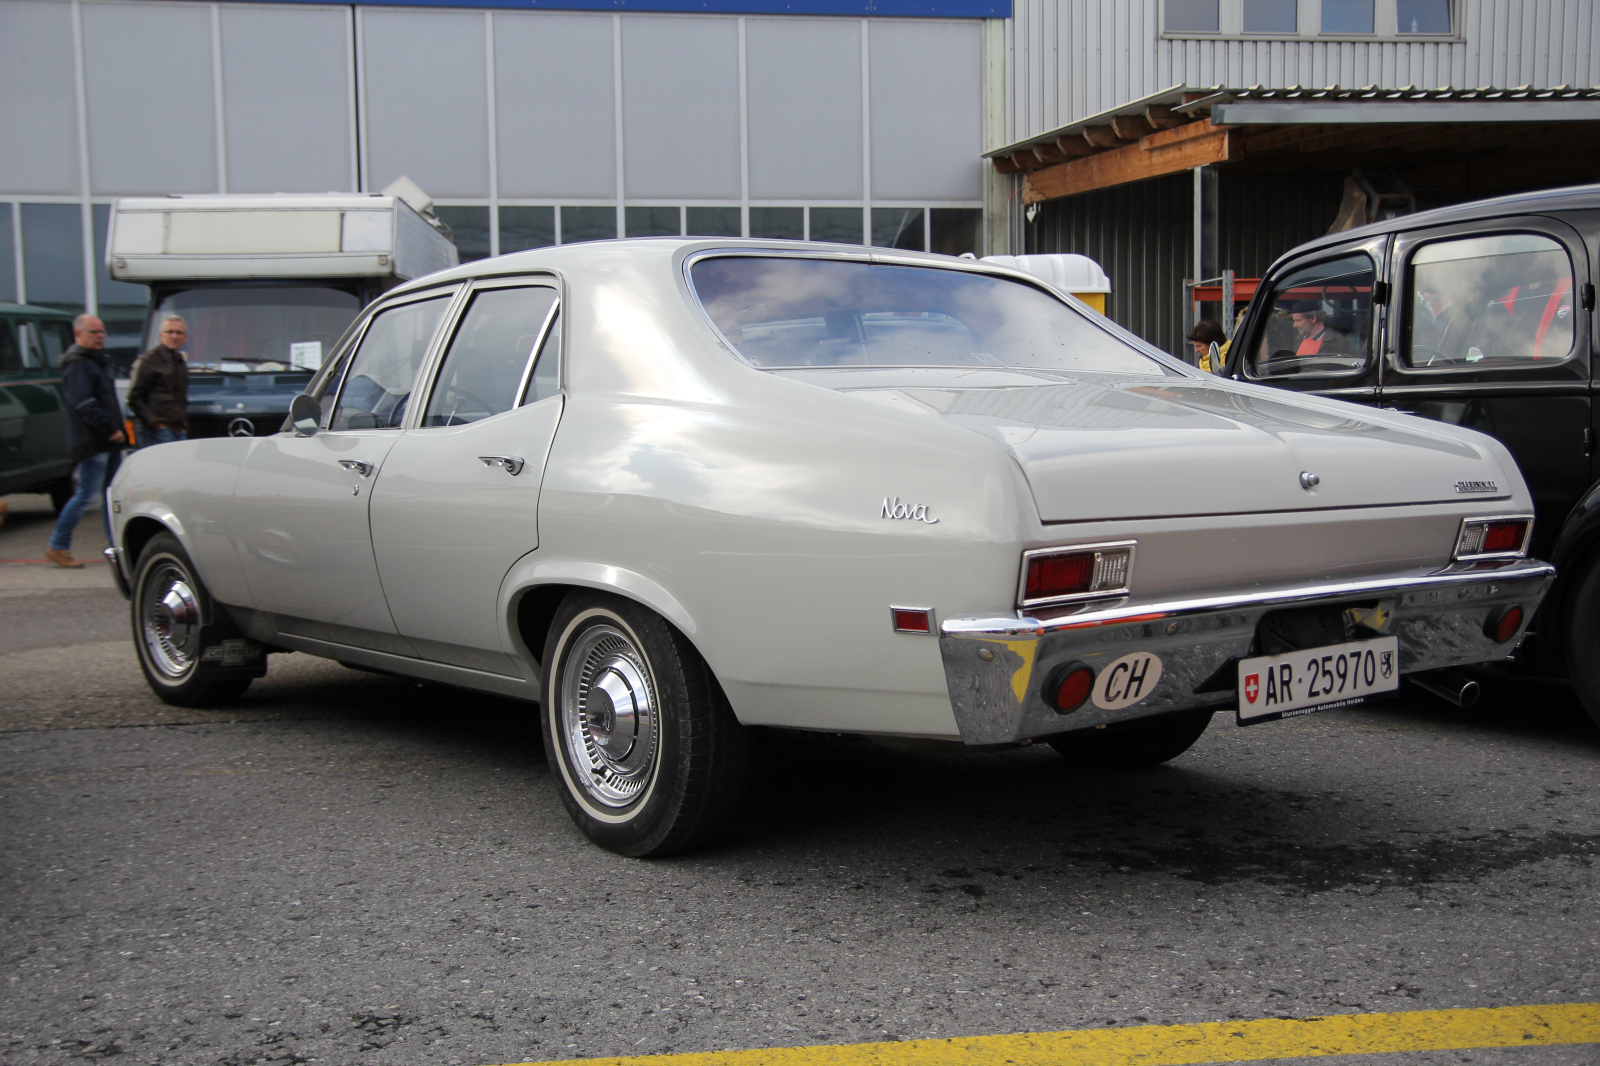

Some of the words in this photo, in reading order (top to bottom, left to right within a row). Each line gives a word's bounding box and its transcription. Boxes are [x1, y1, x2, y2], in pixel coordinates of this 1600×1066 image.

[880, 496, 940, 524] Nova
[1104, 657, 1151, 703] CH
[1317, 701, 1346, 710] Automobile
